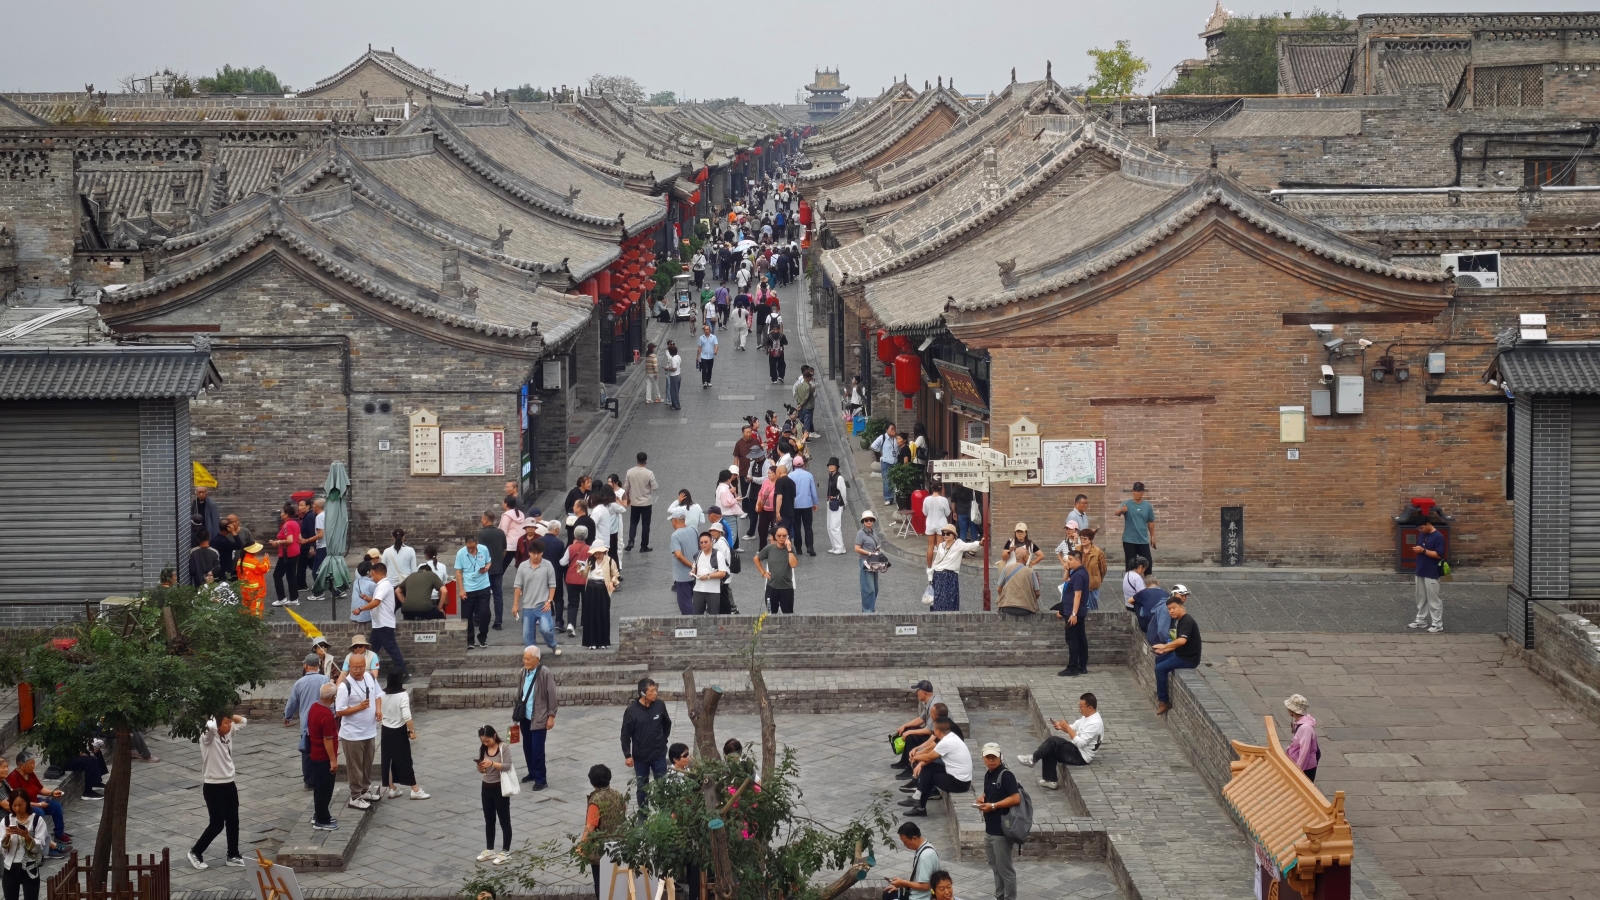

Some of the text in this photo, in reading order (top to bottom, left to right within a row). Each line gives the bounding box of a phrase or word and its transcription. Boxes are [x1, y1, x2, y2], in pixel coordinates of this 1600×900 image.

[942, 460, 974, 468] 西南门头街
